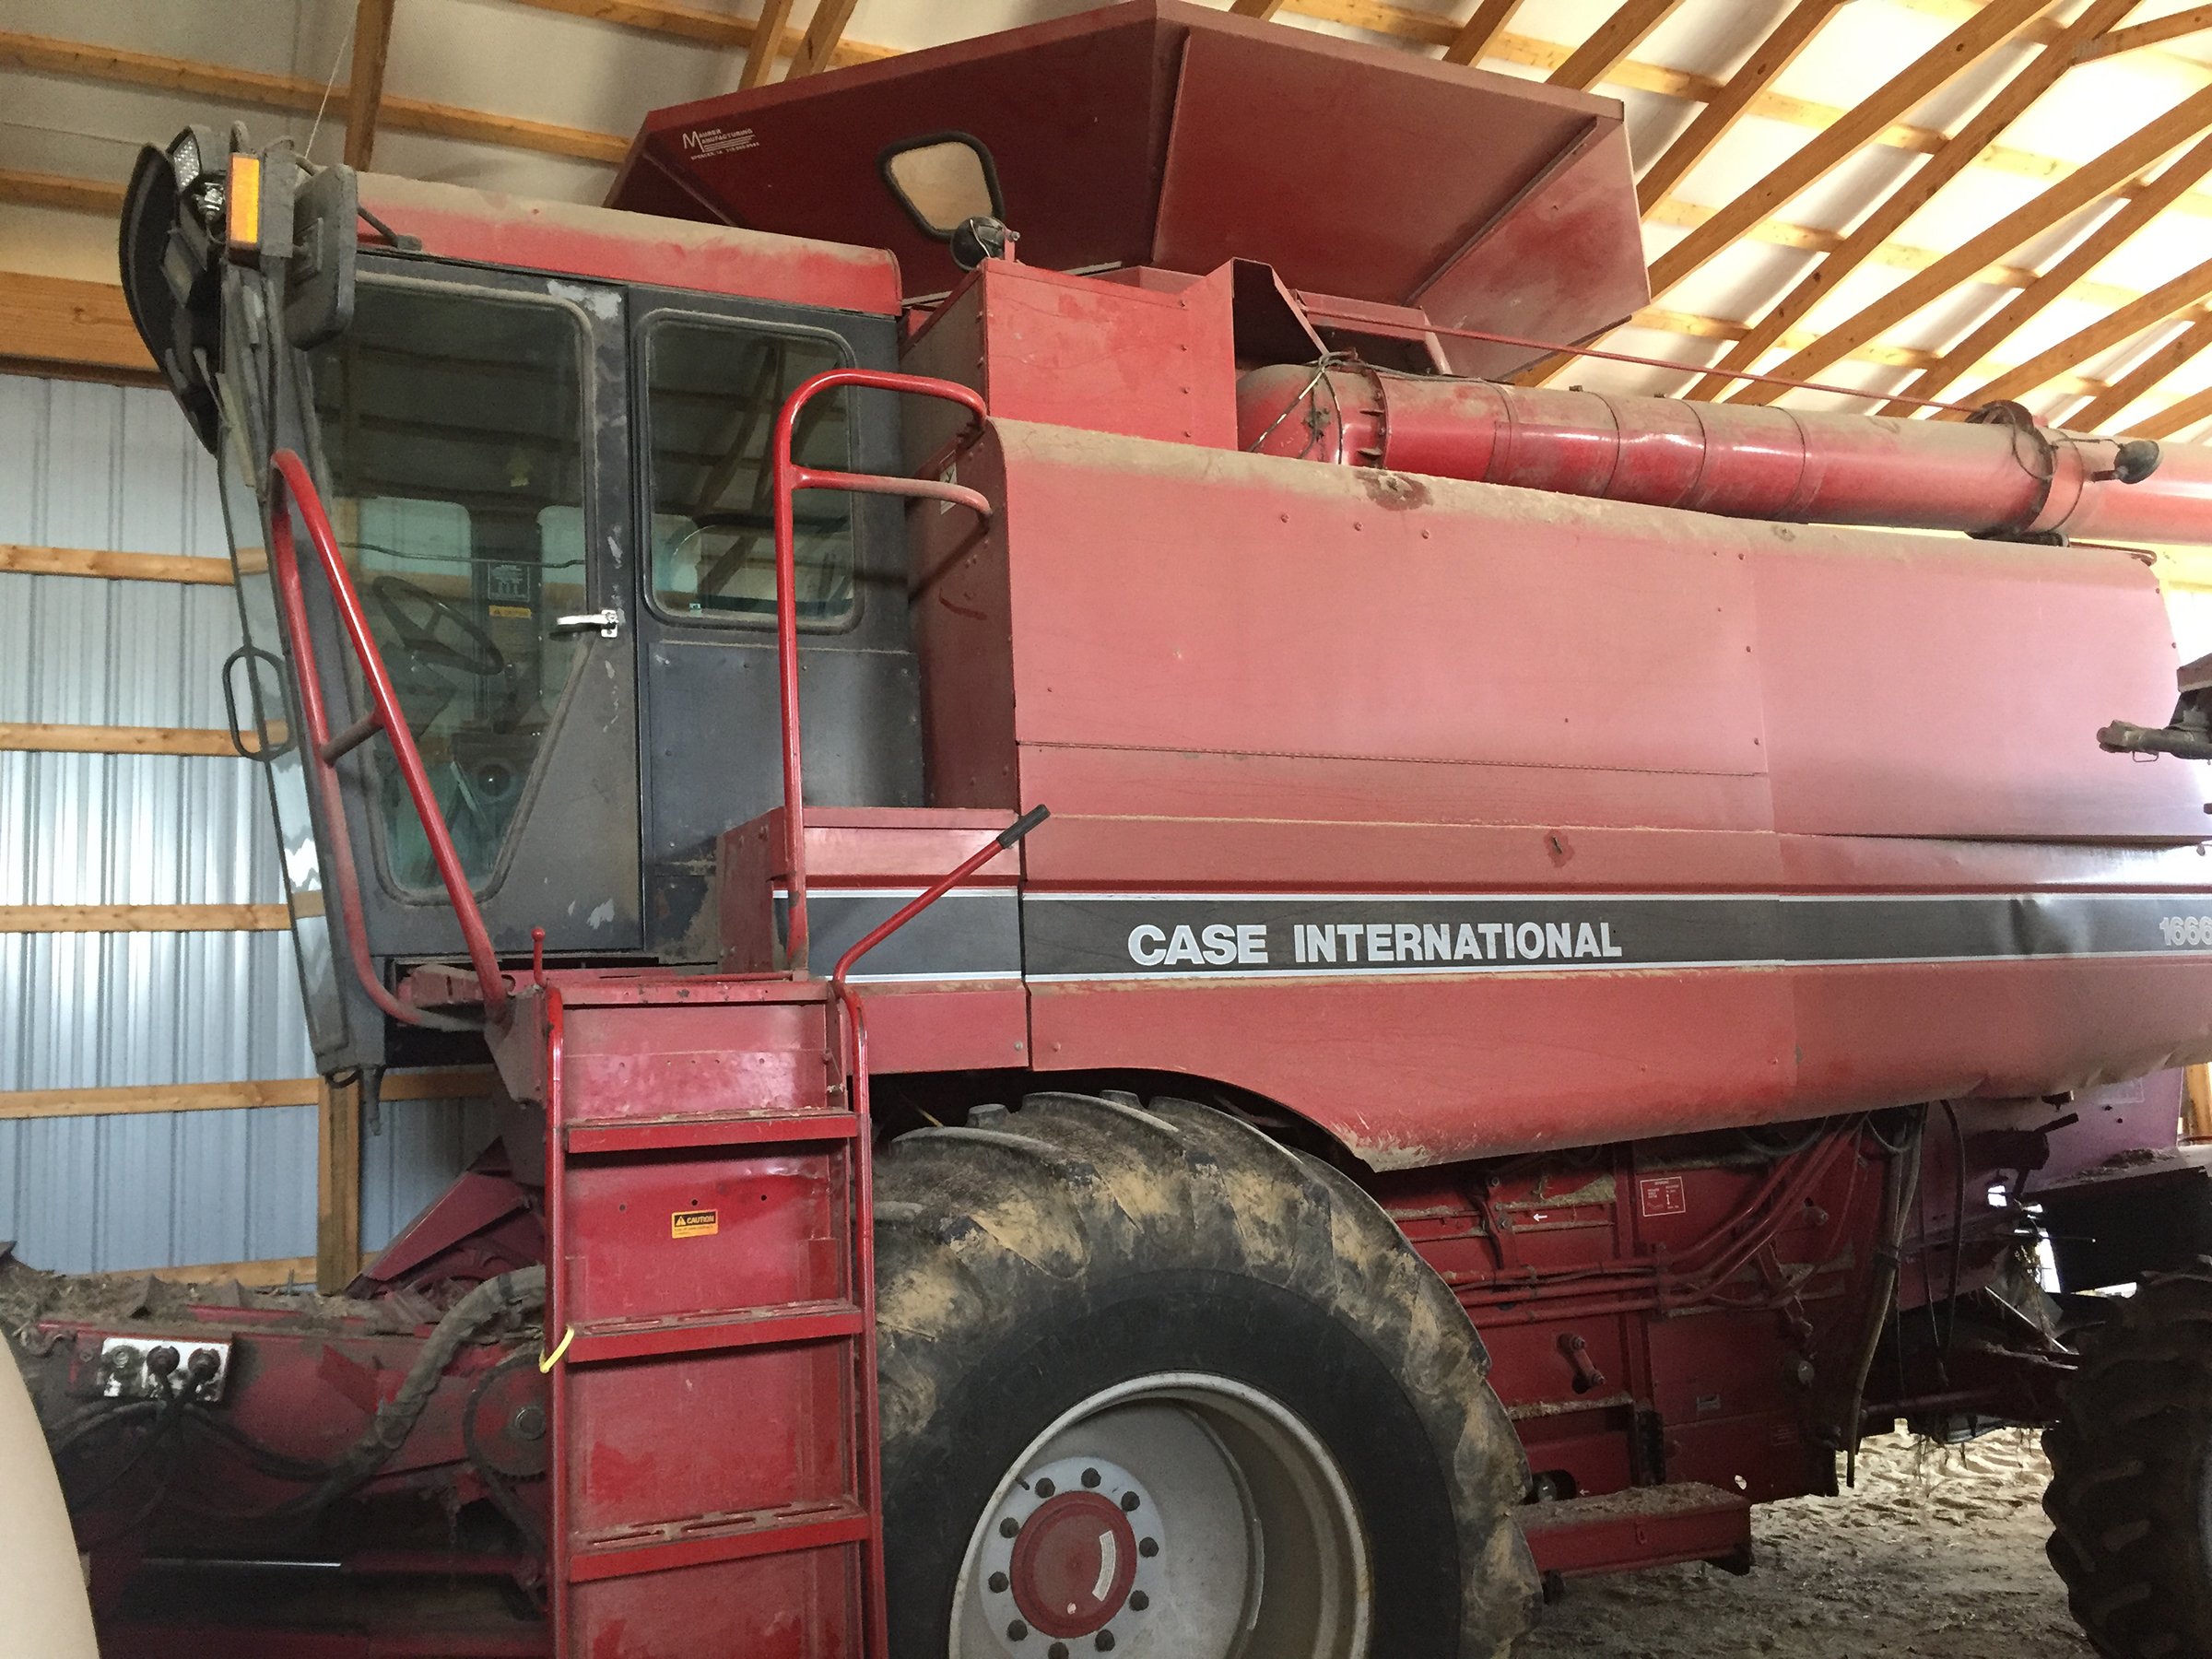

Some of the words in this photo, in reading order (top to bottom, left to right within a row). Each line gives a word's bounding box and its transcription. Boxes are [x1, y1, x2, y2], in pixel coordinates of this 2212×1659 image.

[1127, 924, 1268, 966] CASE
[1294, 922, 1623, 963] INTERNATIONAL
[687, 1215, 714, 1224] CAUTION
